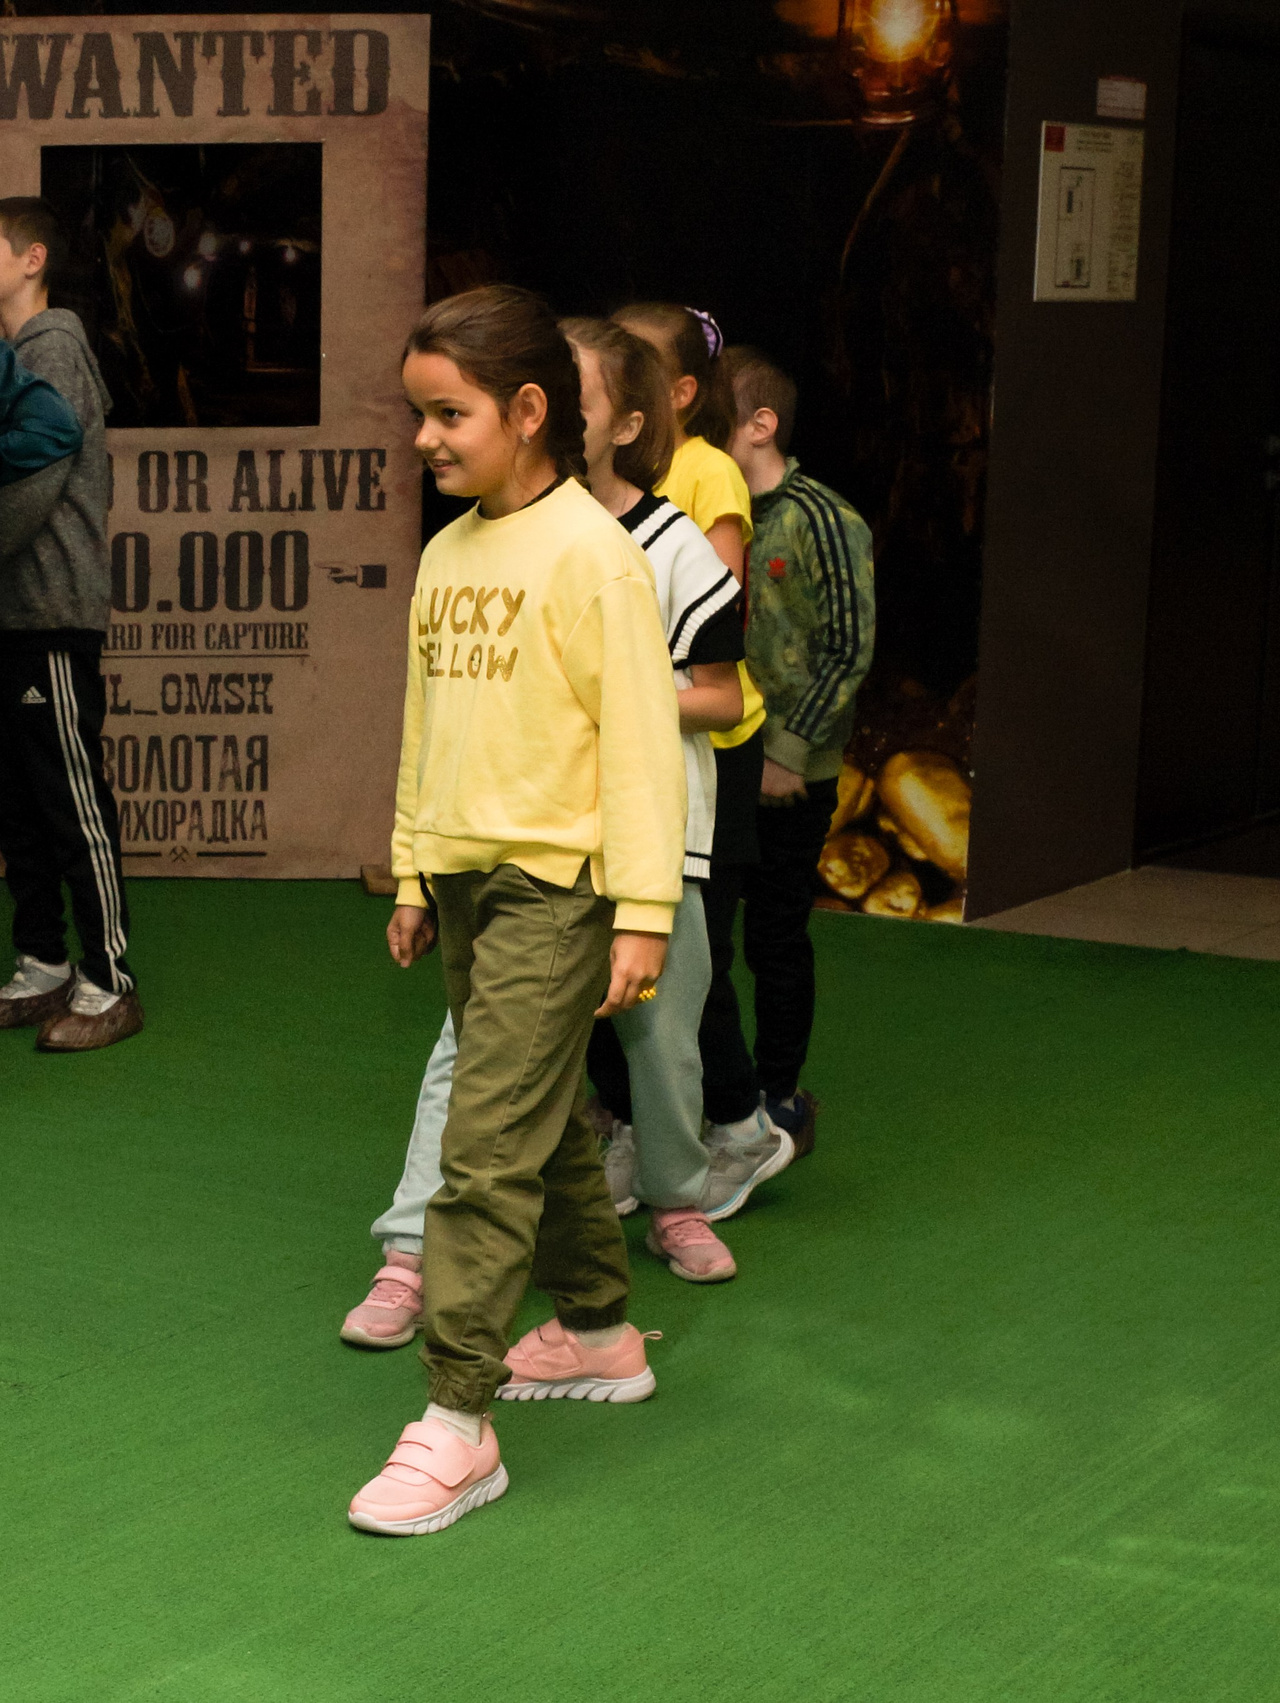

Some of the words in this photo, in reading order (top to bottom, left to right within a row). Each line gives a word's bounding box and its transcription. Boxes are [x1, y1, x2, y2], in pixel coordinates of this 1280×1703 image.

[137, 450, 211, 513] OR
[228, 447, 387, 512] ALIVE
[110, 530, 310, 613] 0.000
[103, 623, 143, 651] RD
[151, 622, 196, 650] FOR
[204, 621, 309, 650] CAPTURE
[108, 672, 274, 716] L_OMSK
[120, 799, 268, 844] ИХОРАДКА
